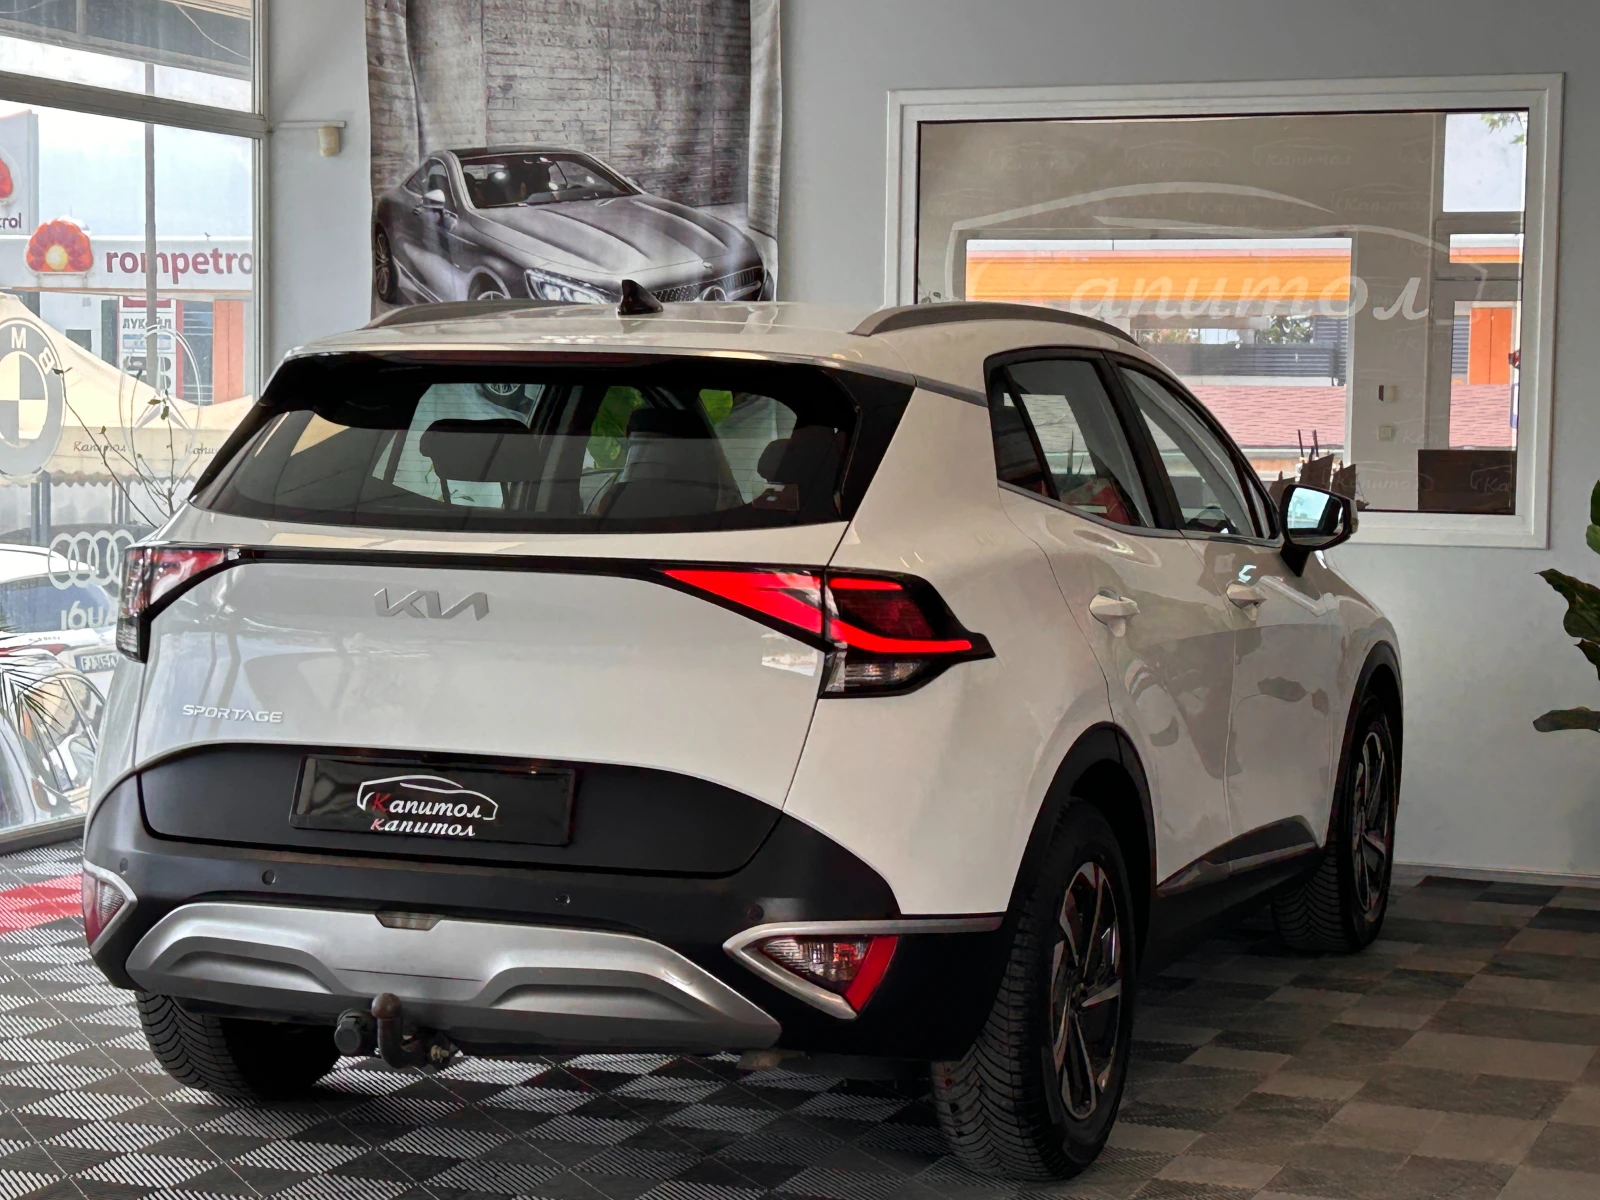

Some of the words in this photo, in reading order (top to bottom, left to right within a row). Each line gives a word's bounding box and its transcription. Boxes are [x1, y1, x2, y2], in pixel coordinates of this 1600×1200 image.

[1066, 273, 1430, 322] апитол
[122, 317, 172, 330] ЛУКЙЛ
[374, 588, 490, 621] KIA
[182, 704, 284, 723] SPORTAGE
[371, 791, 482, 819] Капитол
